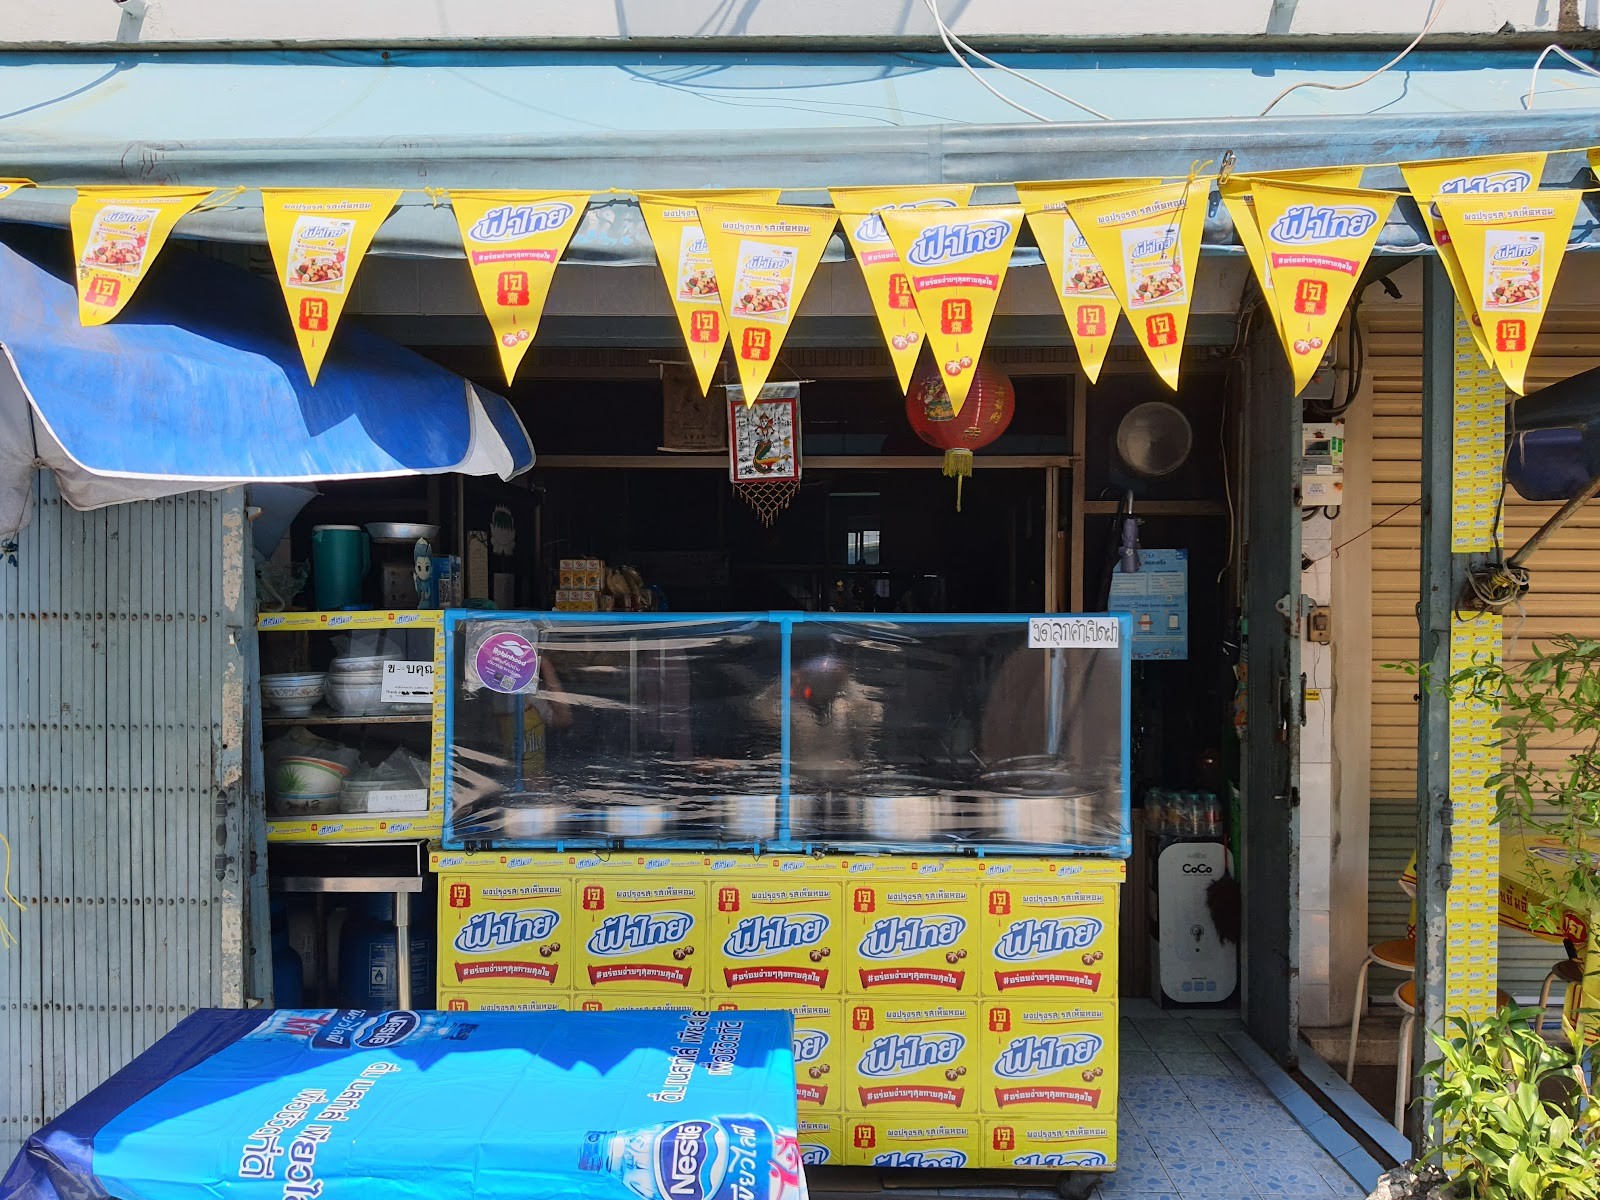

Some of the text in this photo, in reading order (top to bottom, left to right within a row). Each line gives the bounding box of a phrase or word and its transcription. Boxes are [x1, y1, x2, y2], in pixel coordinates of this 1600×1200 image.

[301, 226, 346, 239] ฟ้าไทย
[477, 206, 569, 238] ฟ้าไทย
[1278, 206, 1372, 241] ฟ้าไทย
[914, 224, 1005, 262] ฟ้าไทย
[1494, 243, 1537, 260] ฟ้าไทย
[388, 664, 434, 676] ขบคุณ
[1182, 864, 1212, 874] CoCo
[461, 911, 554, 949] ฟ้าไทย
[595, 914, 688, 952] ฟ้าไทย
[730, 916, 824, 954] ฟ้าไทย
[866, 917, 960, 956] ฟ้าไทย
[1001, 919, 1097, 958] ฟ้าไทย
[866, 1034, 960, 1073] ฟ้าไทย
[1002, 1036, 1097, 1074] ฟ้าไทย
